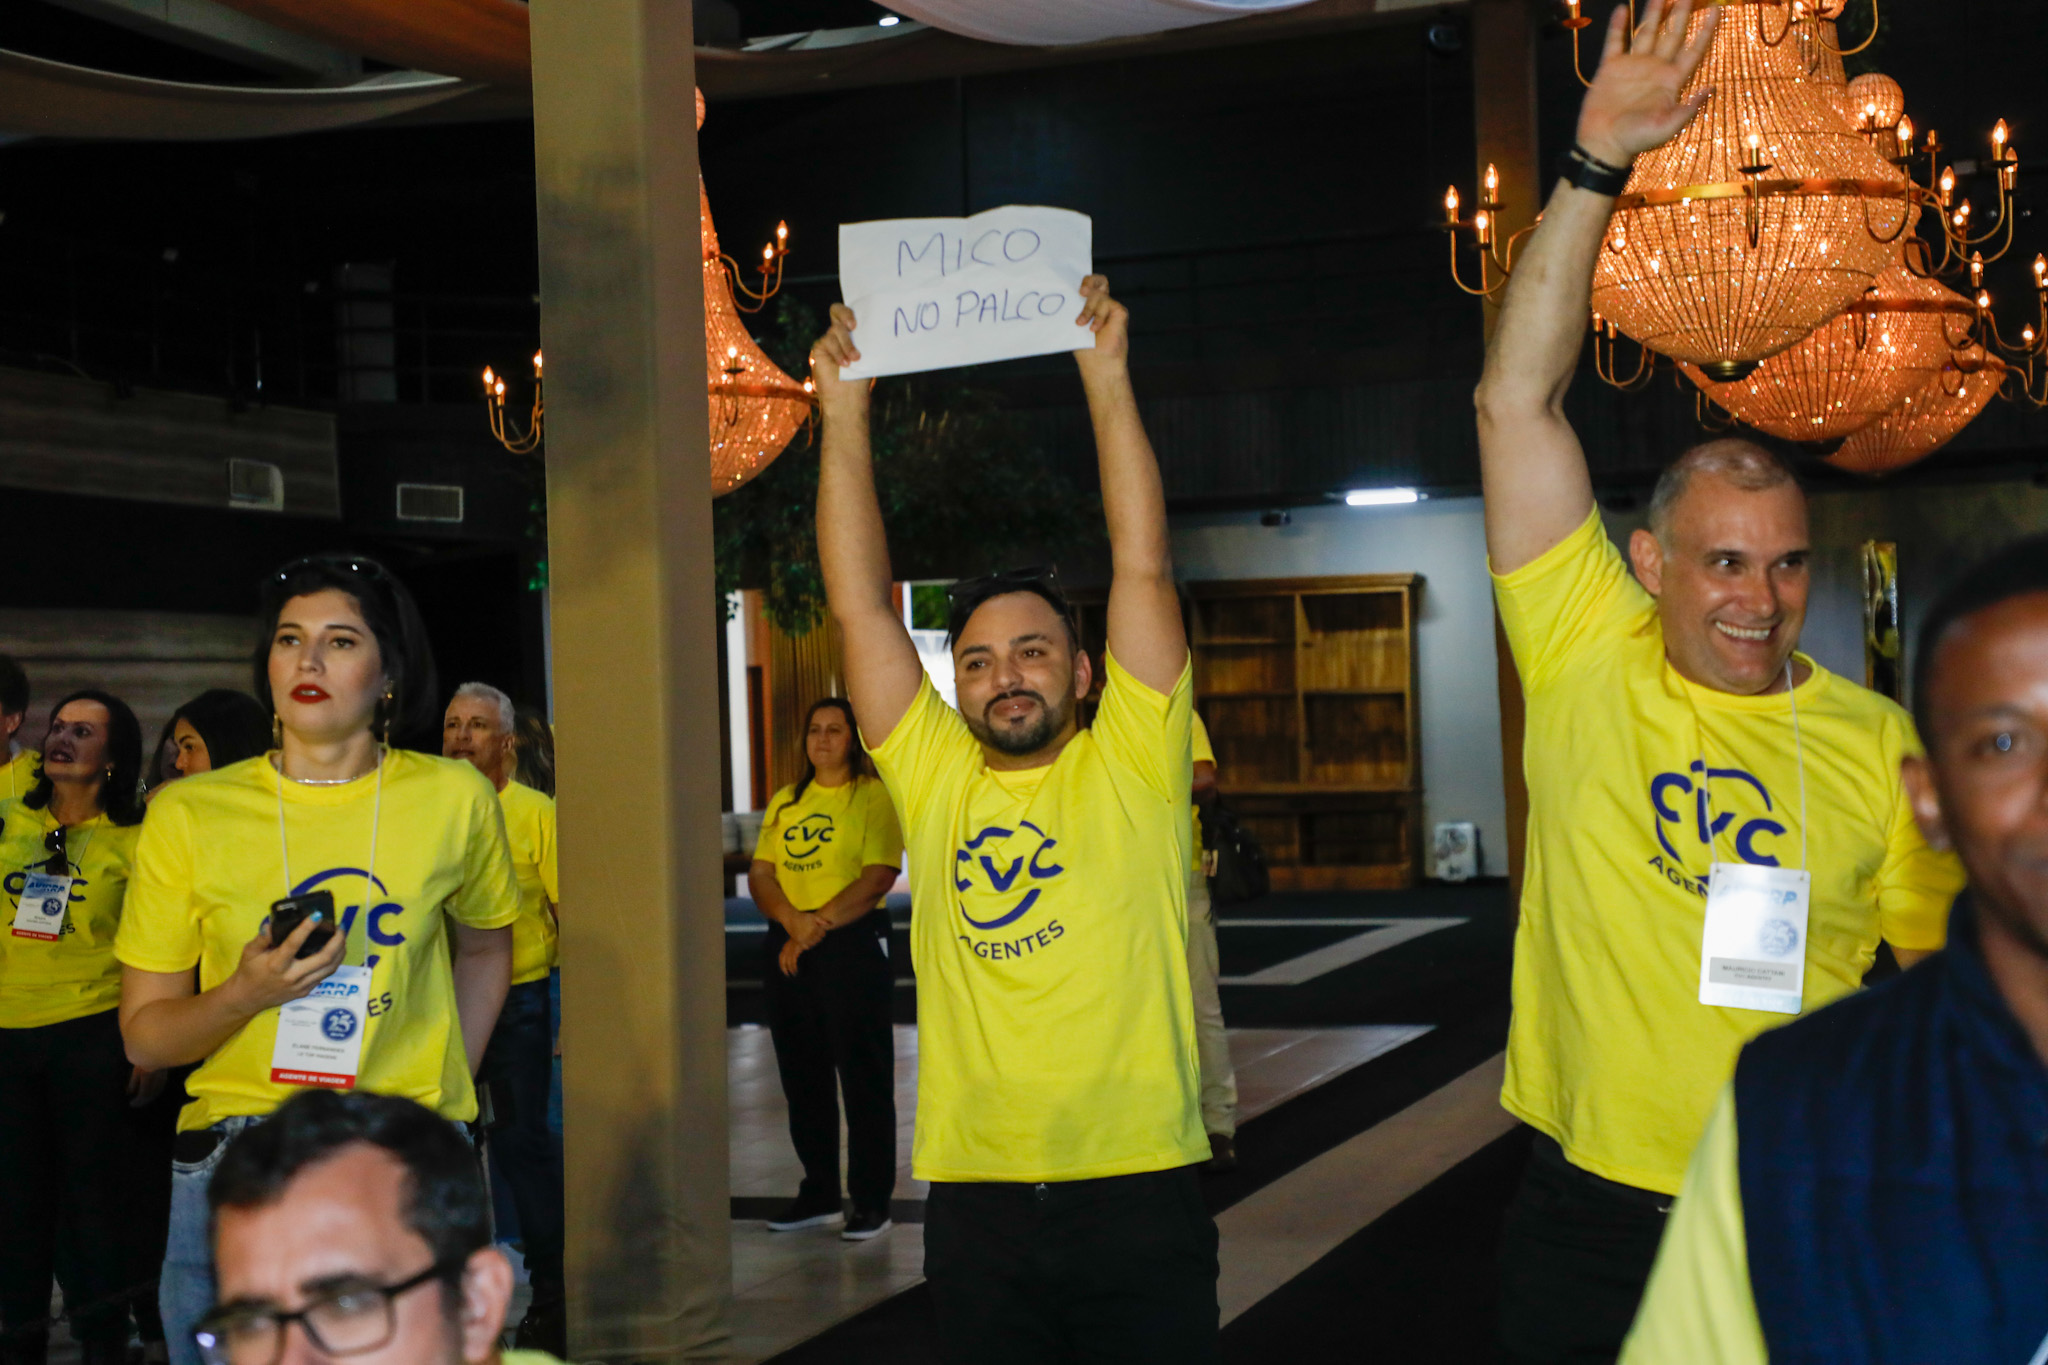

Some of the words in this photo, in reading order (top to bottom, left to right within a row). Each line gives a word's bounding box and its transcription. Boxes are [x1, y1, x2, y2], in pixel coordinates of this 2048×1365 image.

[898, 228, 1041, 277] MICO
[893, 300, 940, 337] NO
[955, 288, 1066, 328] PALCO
[783, 825, 836, 842] CVC
[1650, 772, 1788, 868] CVC
[3, 871, 89, 902] CC
[782, 860, 823, 872] AGENTES
[955, 838, 1065, 892] CVC
[1648, 855, 1709, 899] AGEN
[279, 1072, 307, 1081] AGENTE
[318, 1076, 346, 1085] VIAGEM
